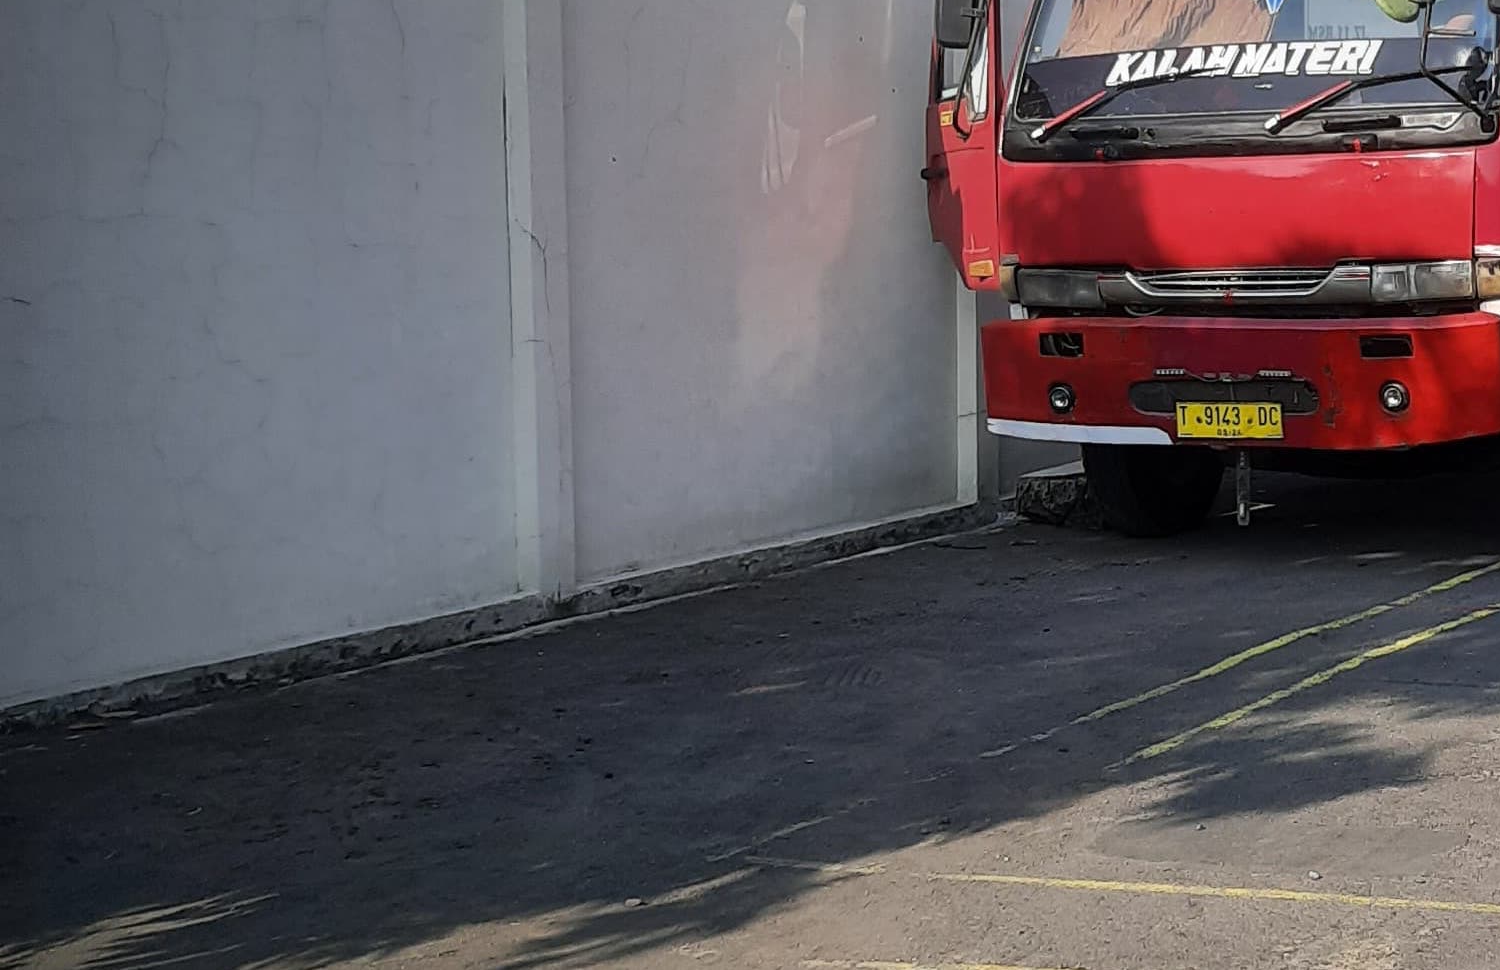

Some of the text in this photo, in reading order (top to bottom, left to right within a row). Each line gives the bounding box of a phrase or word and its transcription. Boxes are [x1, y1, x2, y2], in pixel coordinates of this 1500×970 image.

[1105, 39, 1384, 87] KALAH MATERI
[1179, 405, 1279, 426] T 9143 DC
